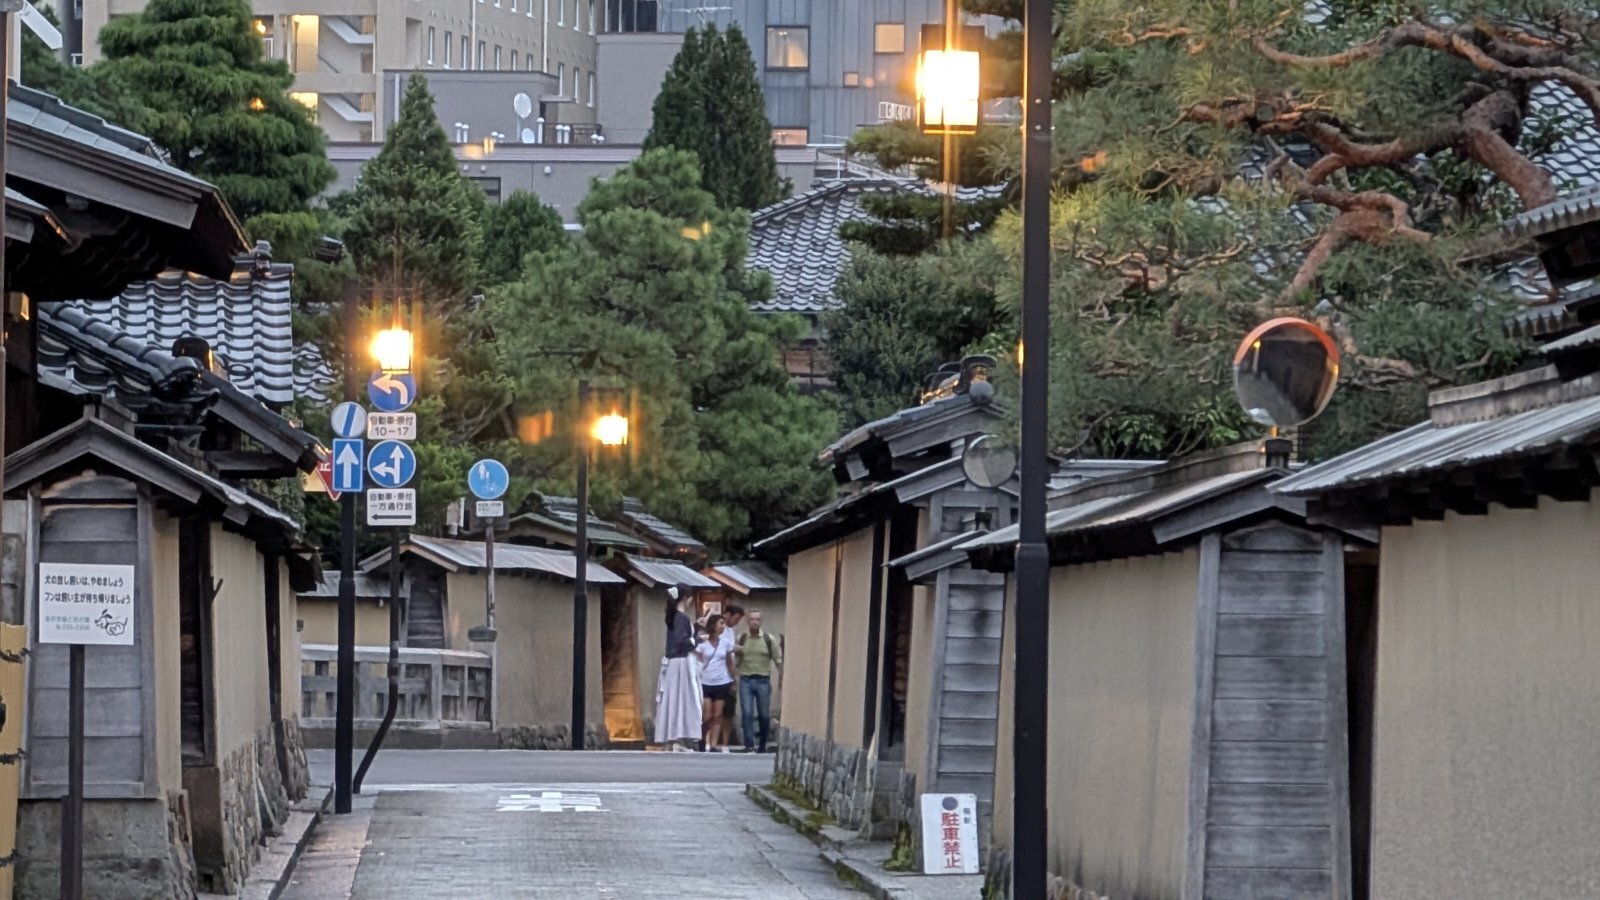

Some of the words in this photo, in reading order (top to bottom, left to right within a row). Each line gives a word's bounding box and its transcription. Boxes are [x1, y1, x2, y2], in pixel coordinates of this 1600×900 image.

[44, 592, 131, 605] フンは飼い主が持ち帰りましょう
[941, 812, 962, 869] 駐車禁止
